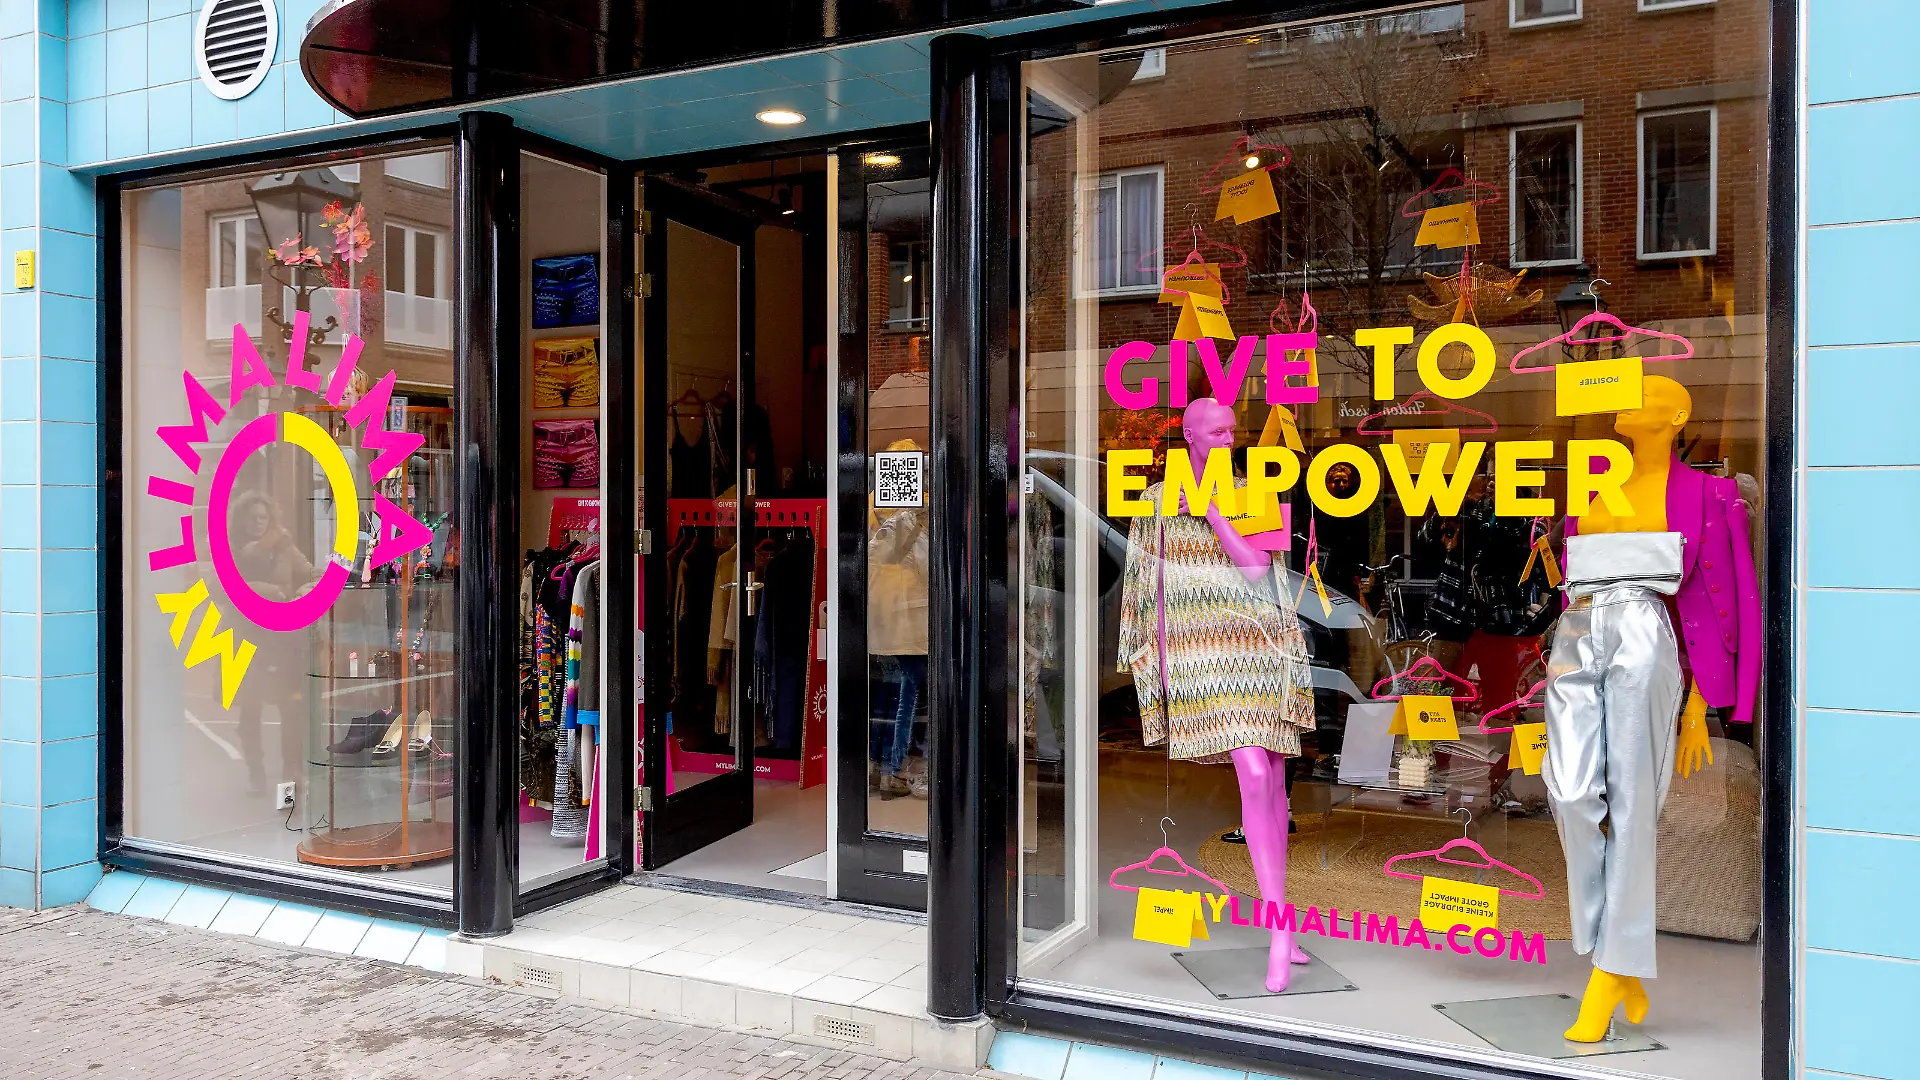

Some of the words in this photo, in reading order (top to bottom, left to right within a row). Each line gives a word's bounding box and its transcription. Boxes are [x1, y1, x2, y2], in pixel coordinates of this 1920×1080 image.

[1105, 332, 1319, 410] GIVE
[1355, 323, 1497, 400] TO
[1580, 376, 1619, 386] POSITIEF
[1107, 440, 1636, 518] EMPOWER
[1226, 512, 1256, 521] OMME...
[1429, 892, 1459, 904] IMPACT
[1461, 897, 1490, 909] GROTE
[1424, 900, 1464, 913] BIJDRAGE
[1465, 907, 1494, 918] KLEINE
